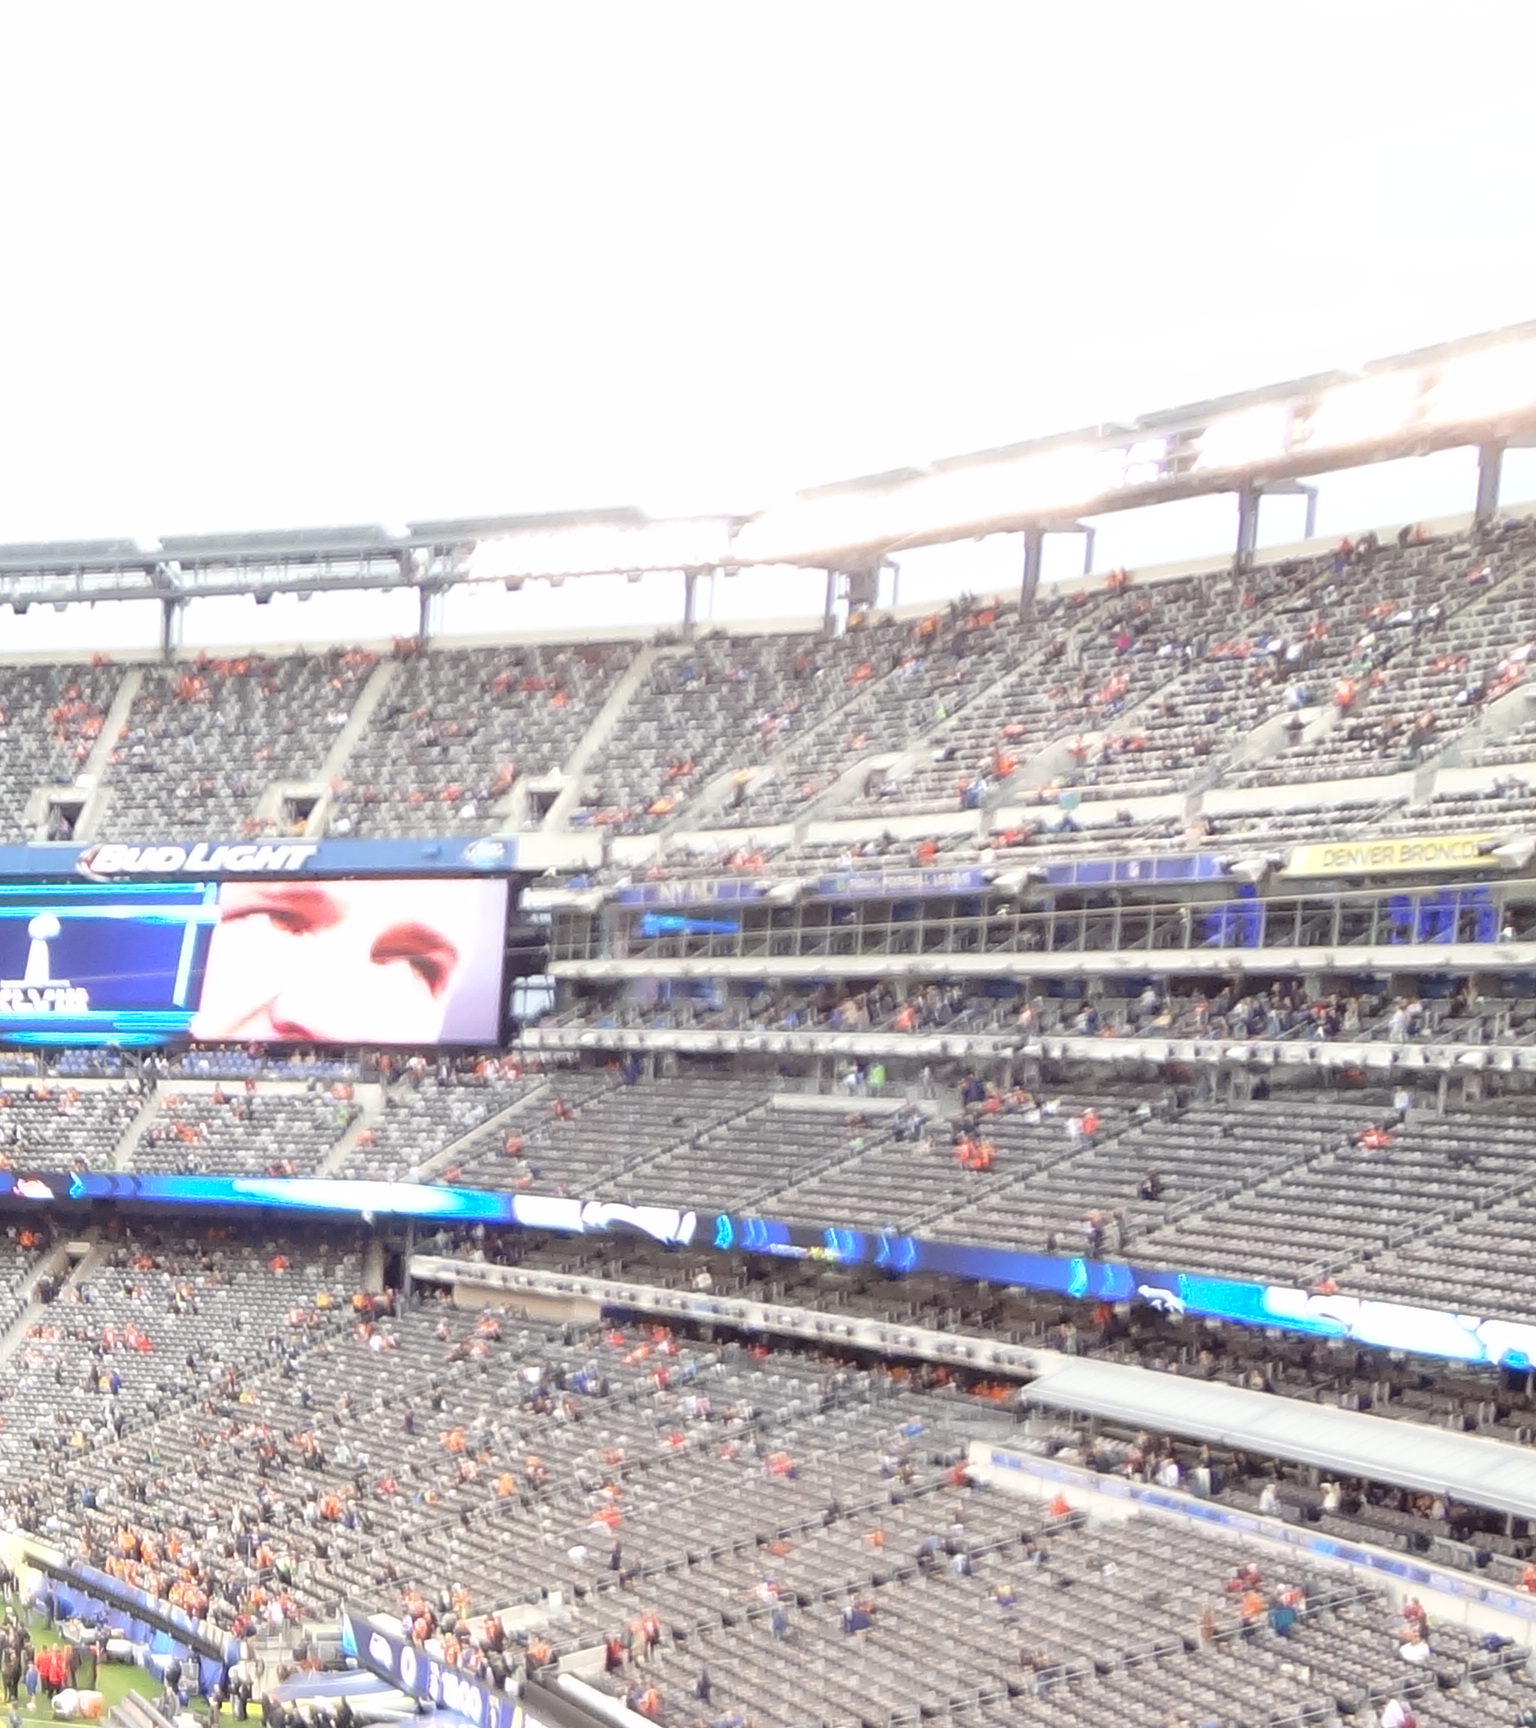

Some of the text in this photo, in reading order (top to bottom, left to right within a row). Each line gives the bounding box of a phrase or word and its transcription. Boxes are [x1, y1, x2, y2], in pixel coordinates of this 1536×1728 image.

[90, 843, 317, 872] BUD LIGHT
[1323, 845, 1395, 867] DENVER
